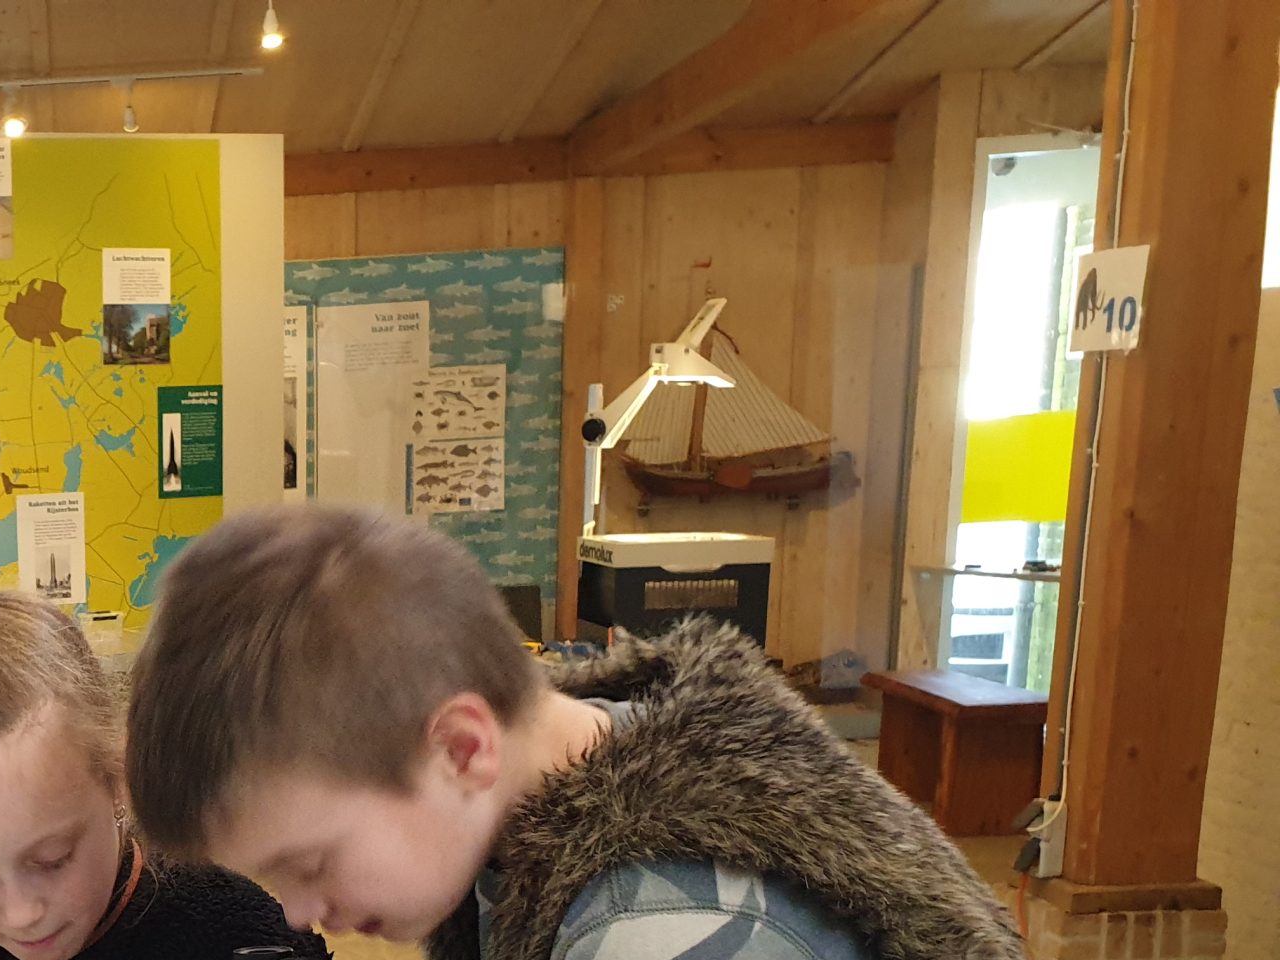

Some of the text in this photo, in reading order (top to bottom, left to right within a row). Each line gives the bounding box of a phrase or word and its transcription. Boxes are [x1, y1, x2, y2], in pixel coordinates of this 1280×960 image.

[375, 311, 420, 322] Van zout
[1102, 296, 1137, 333] 10
[371, 325, 394, 333] naar
